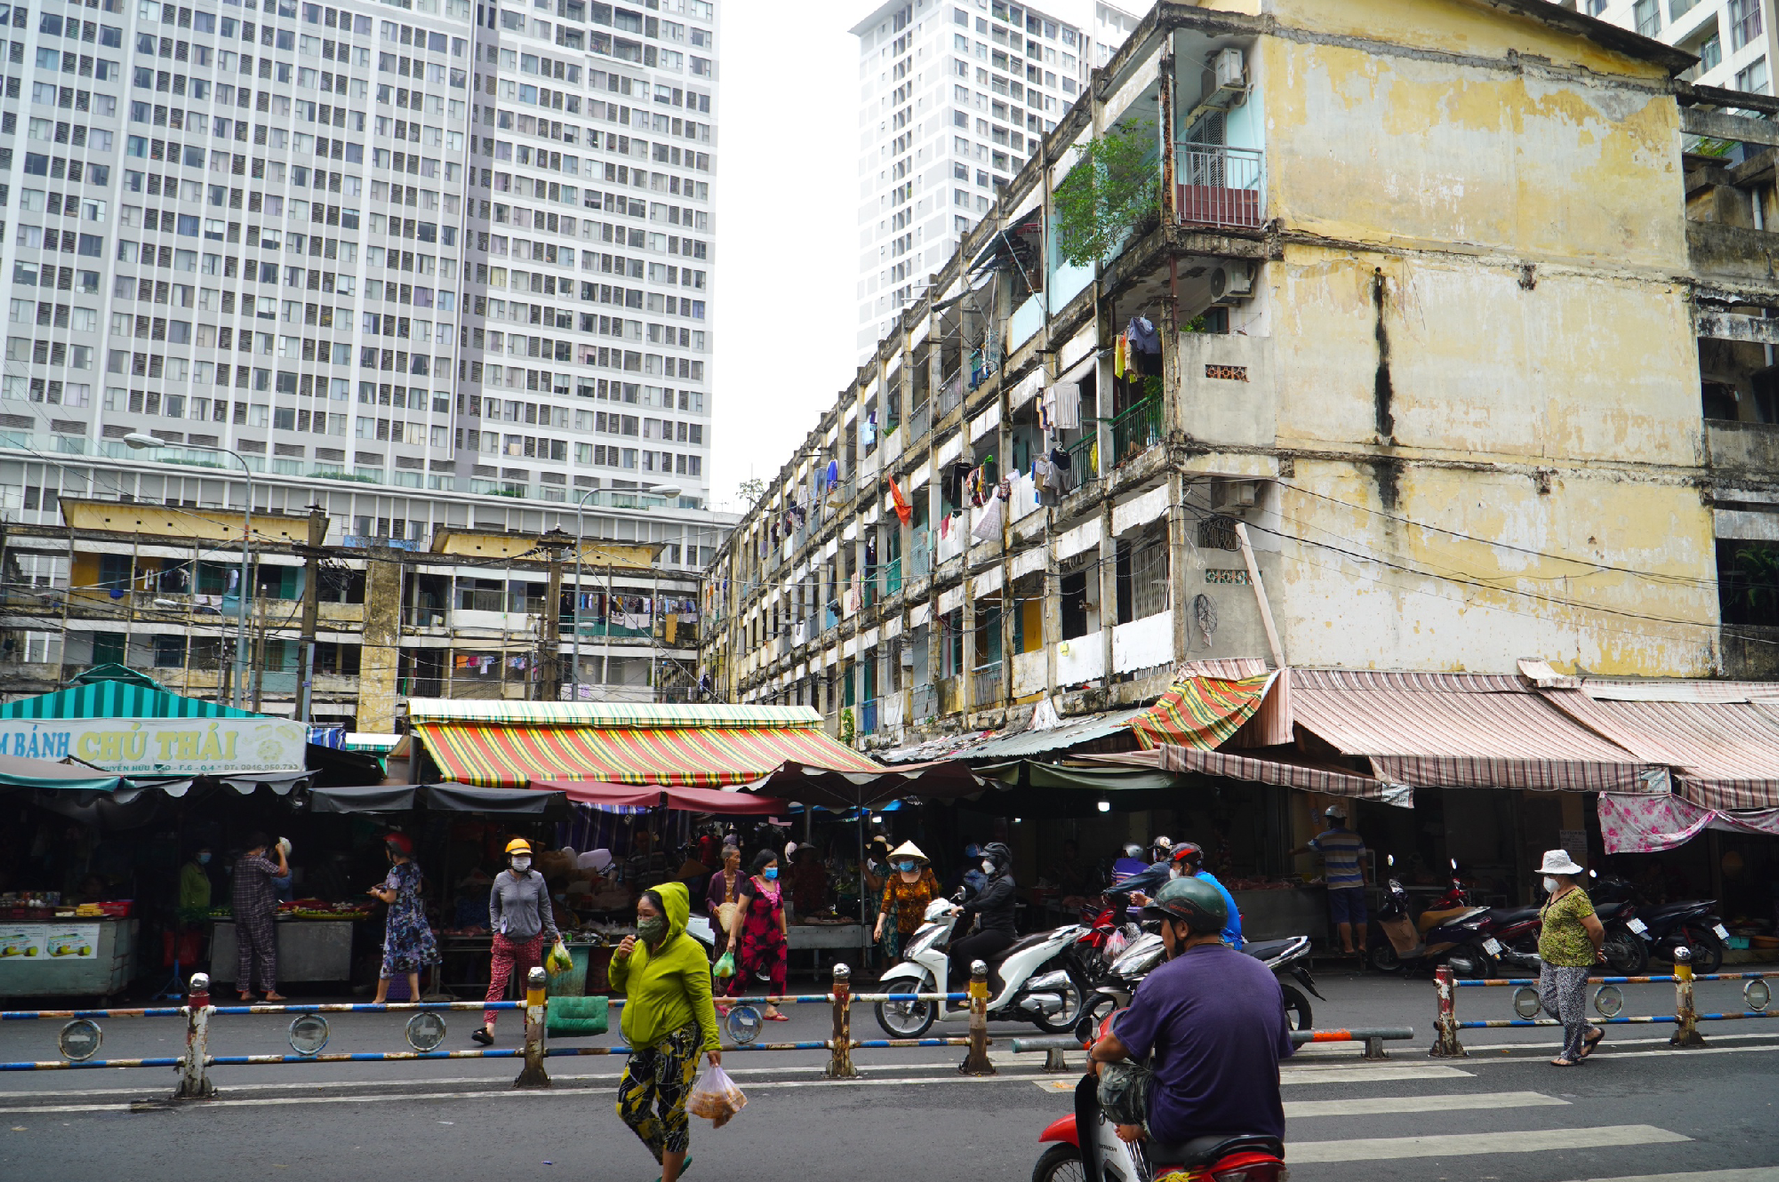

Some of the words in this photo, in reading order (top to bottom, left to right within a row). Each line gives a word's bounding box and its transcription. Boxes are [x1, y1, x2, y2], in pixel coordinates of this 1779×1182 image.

[13, 724, 71, 757] BÁNH
[77, 722, 148, 762] CHÚ
[155, 722, 238, 761] THÁI
